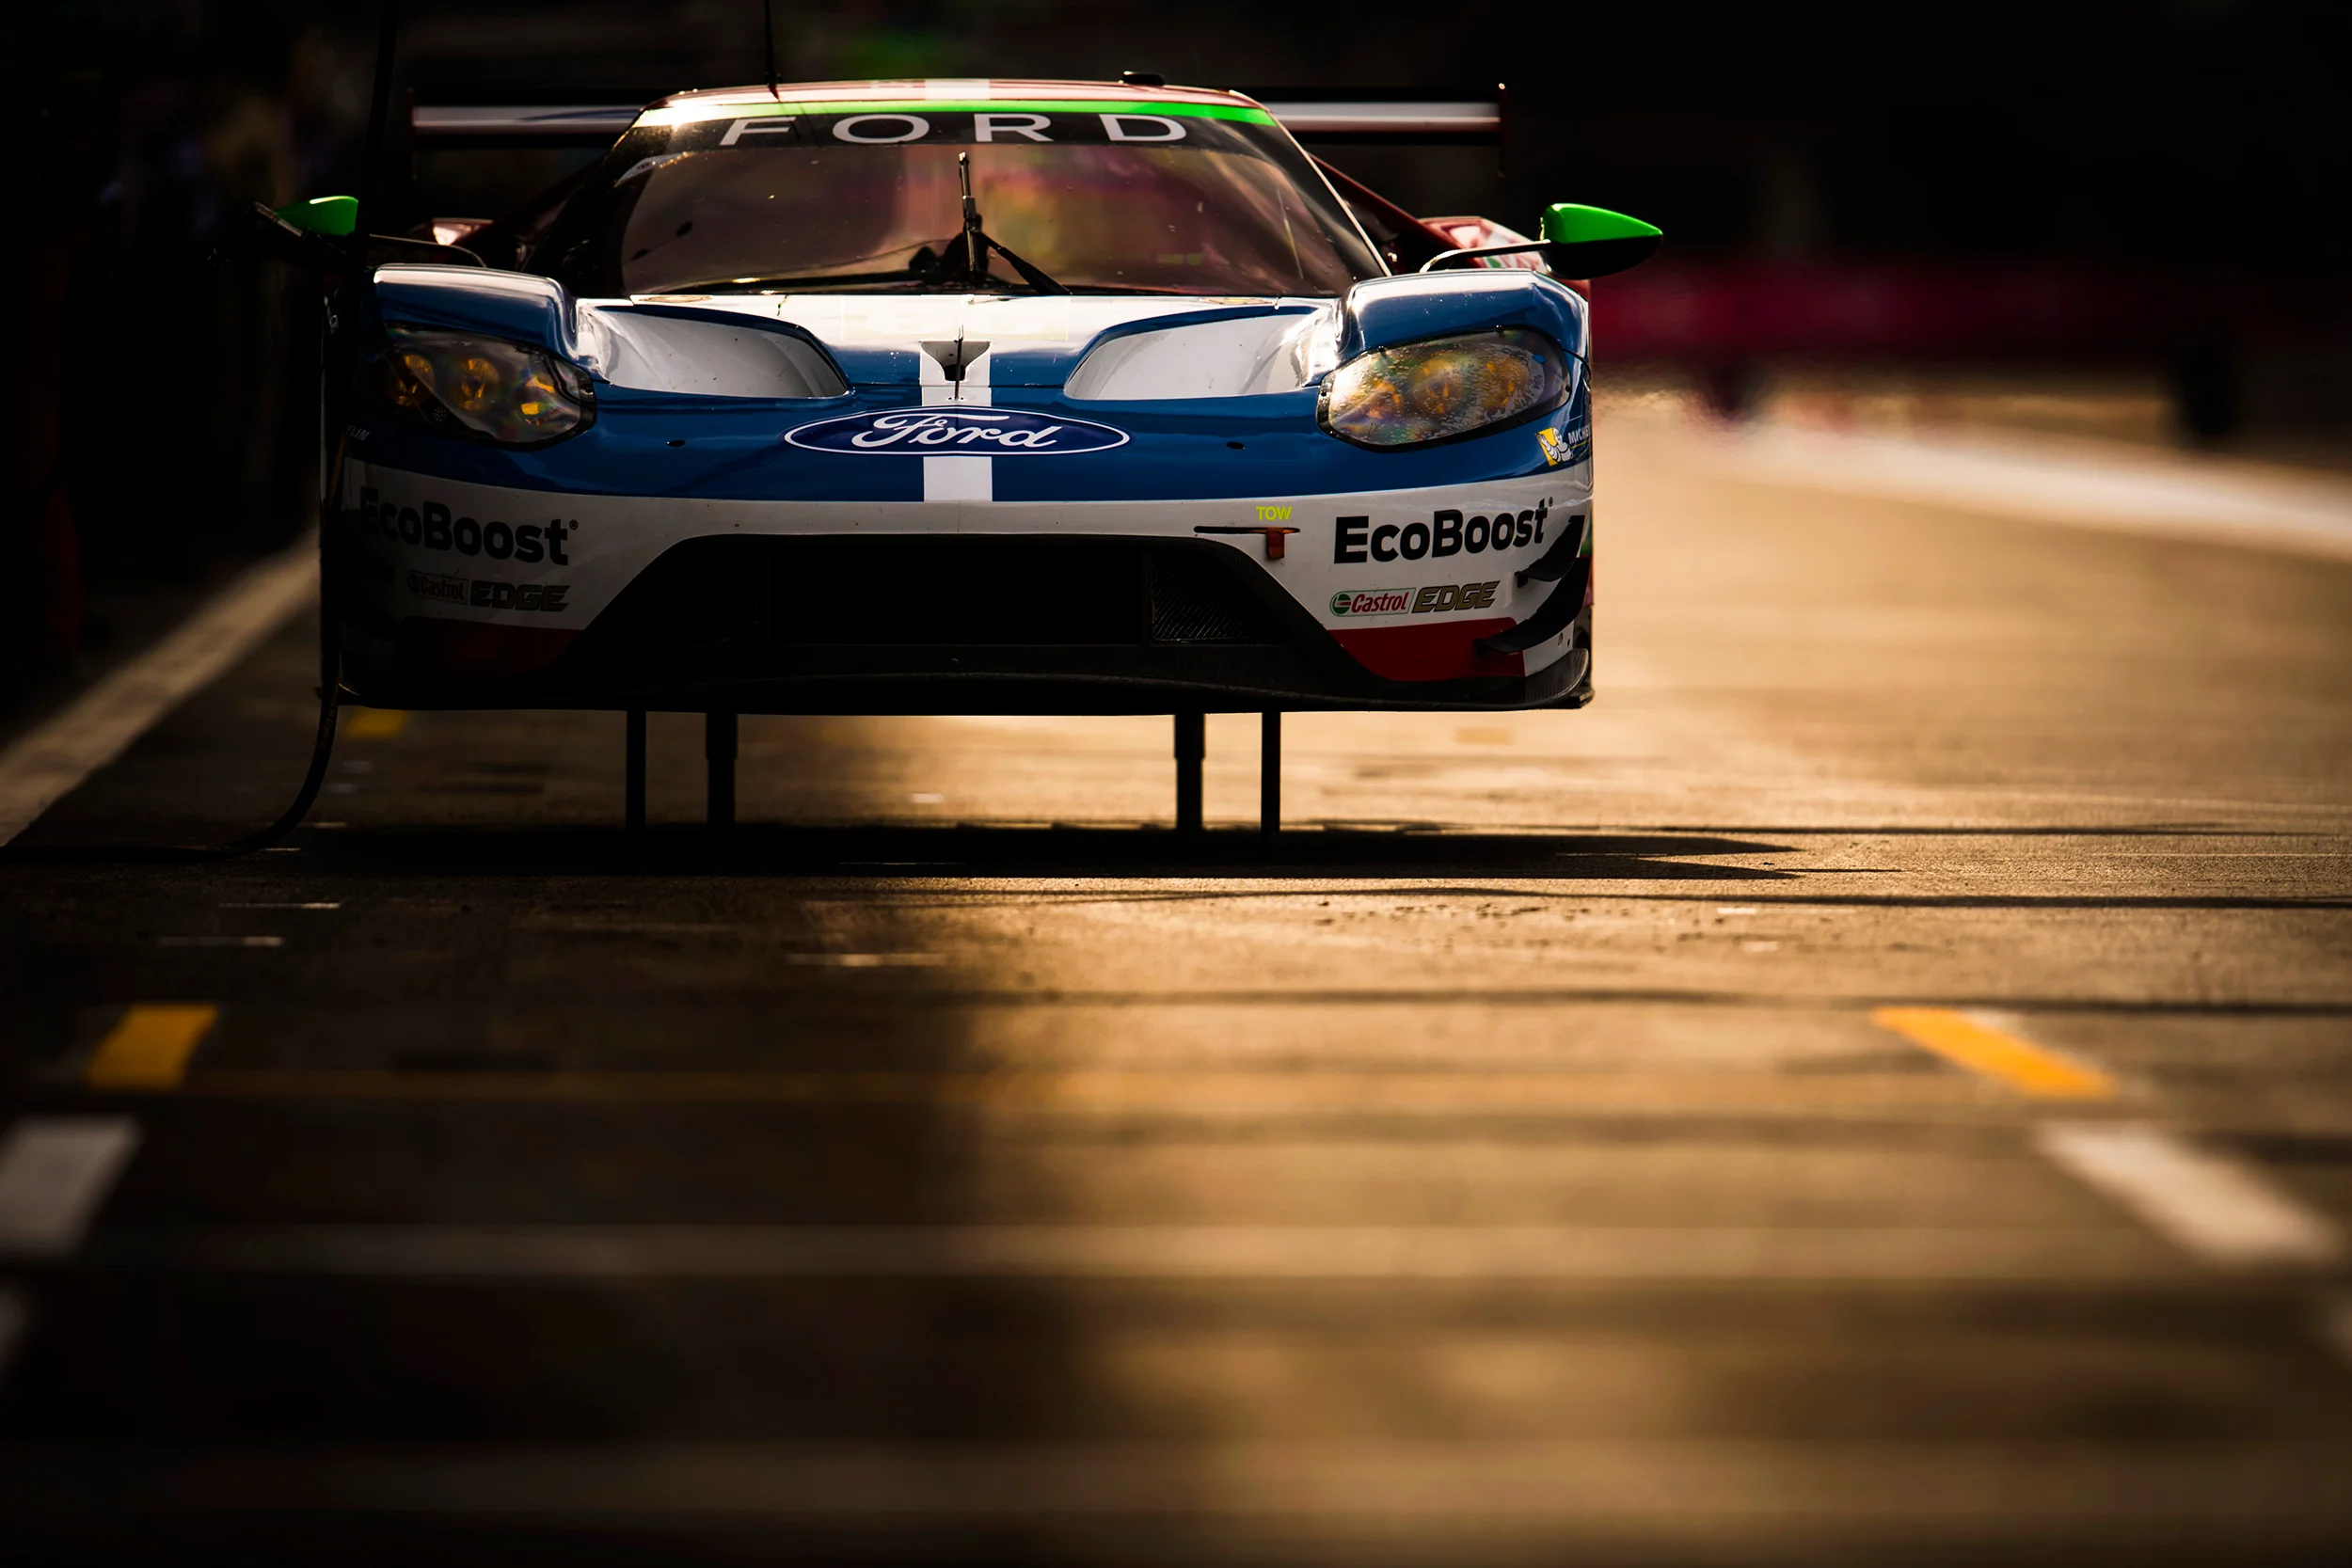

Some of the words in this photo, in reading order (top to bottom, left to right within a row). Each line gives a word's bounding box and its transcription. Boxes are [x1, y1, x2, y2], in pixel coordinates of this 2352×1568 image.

[720, 112, 1187, 146] FORD
[851, 412, 1061, 449] Ford
[1256, 506, 1293, 520] TOW
[420, 577, 465, 601] Castrol
[470, 580, 570, 612] EDGE
[1350, 591, 1410, 613] Castrol
[1410, 580, 1502, 614] EDGE
